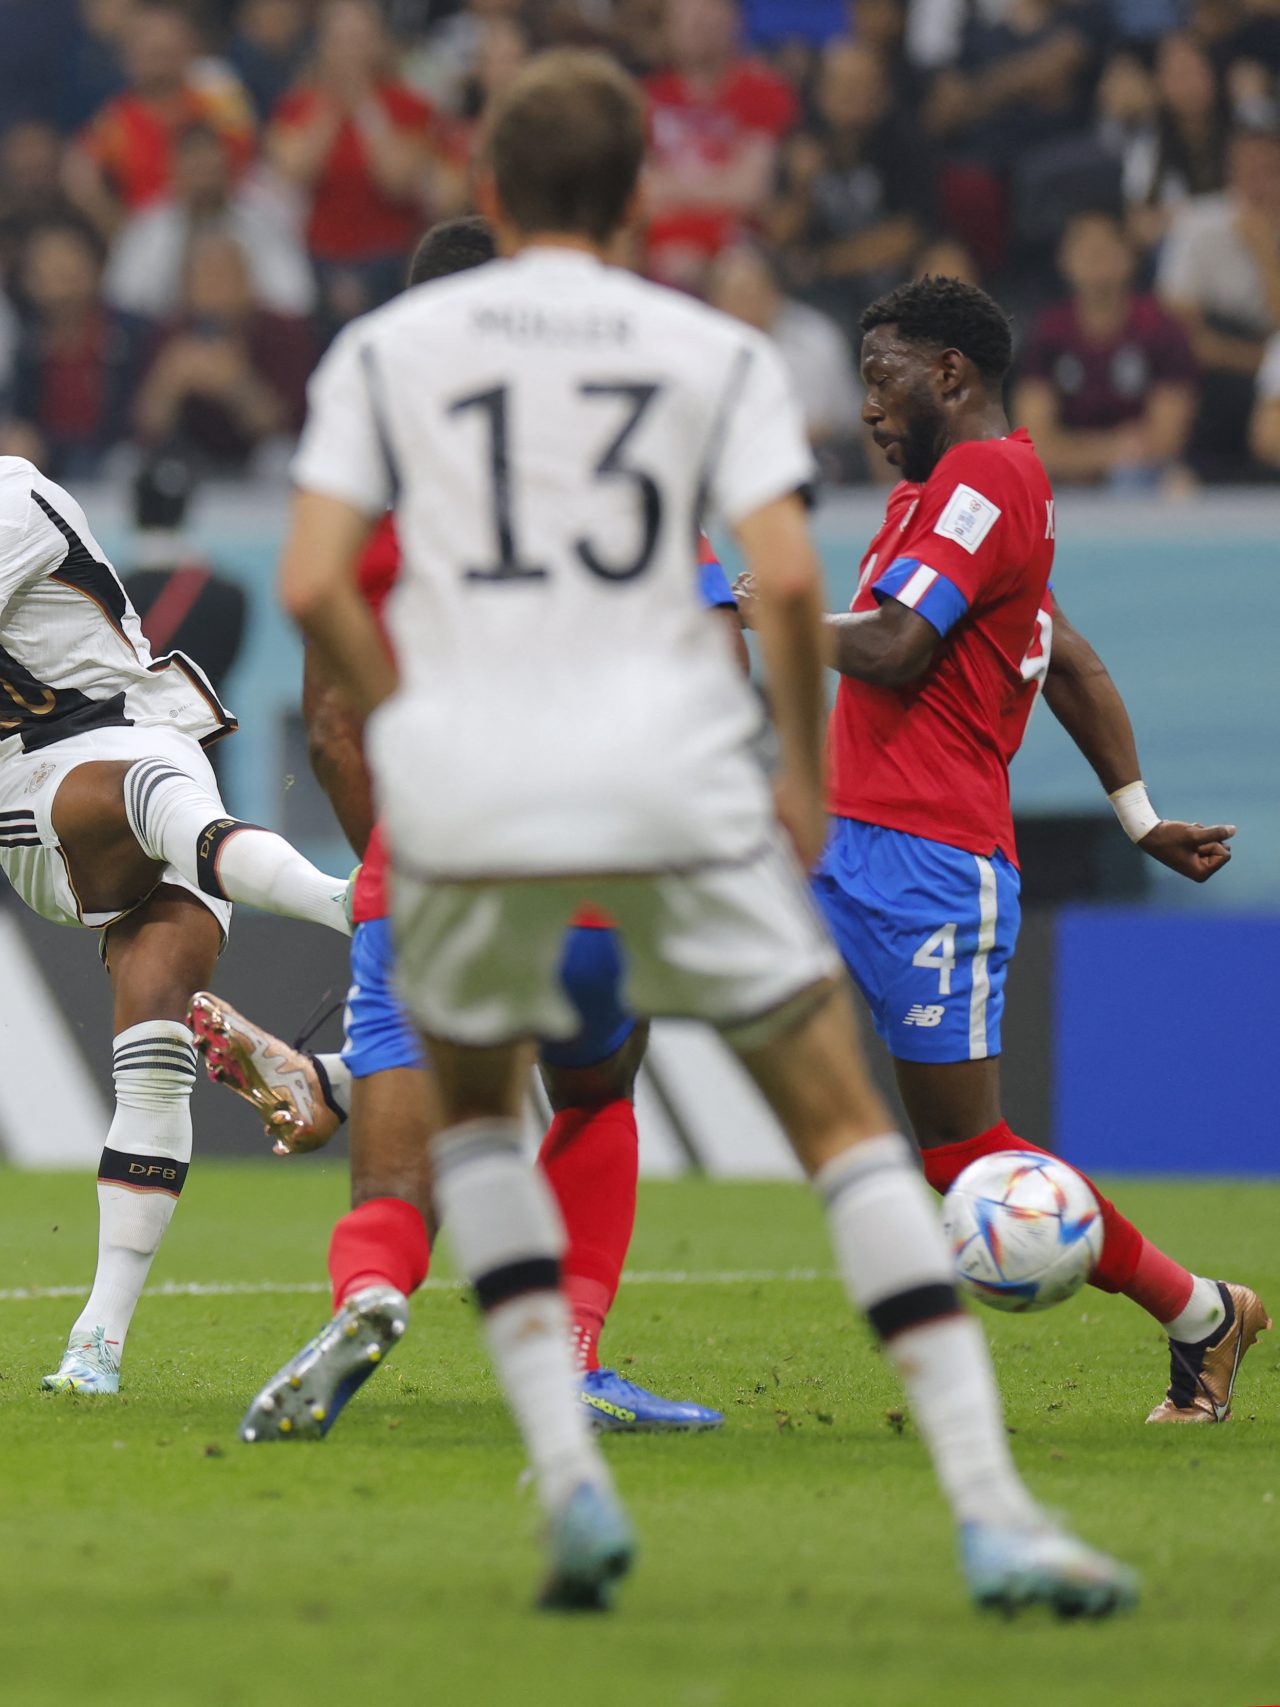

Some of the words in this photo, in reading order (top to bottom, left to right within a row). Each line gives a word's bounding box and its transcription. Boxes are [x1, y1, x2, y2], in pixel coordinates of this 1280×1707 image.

[446, 381, 663, 582] 13
[912, 922, 958, 995] 4
[128, 1162, 177, 1180] DFB
[581, 1391, 637, 1423] balance
